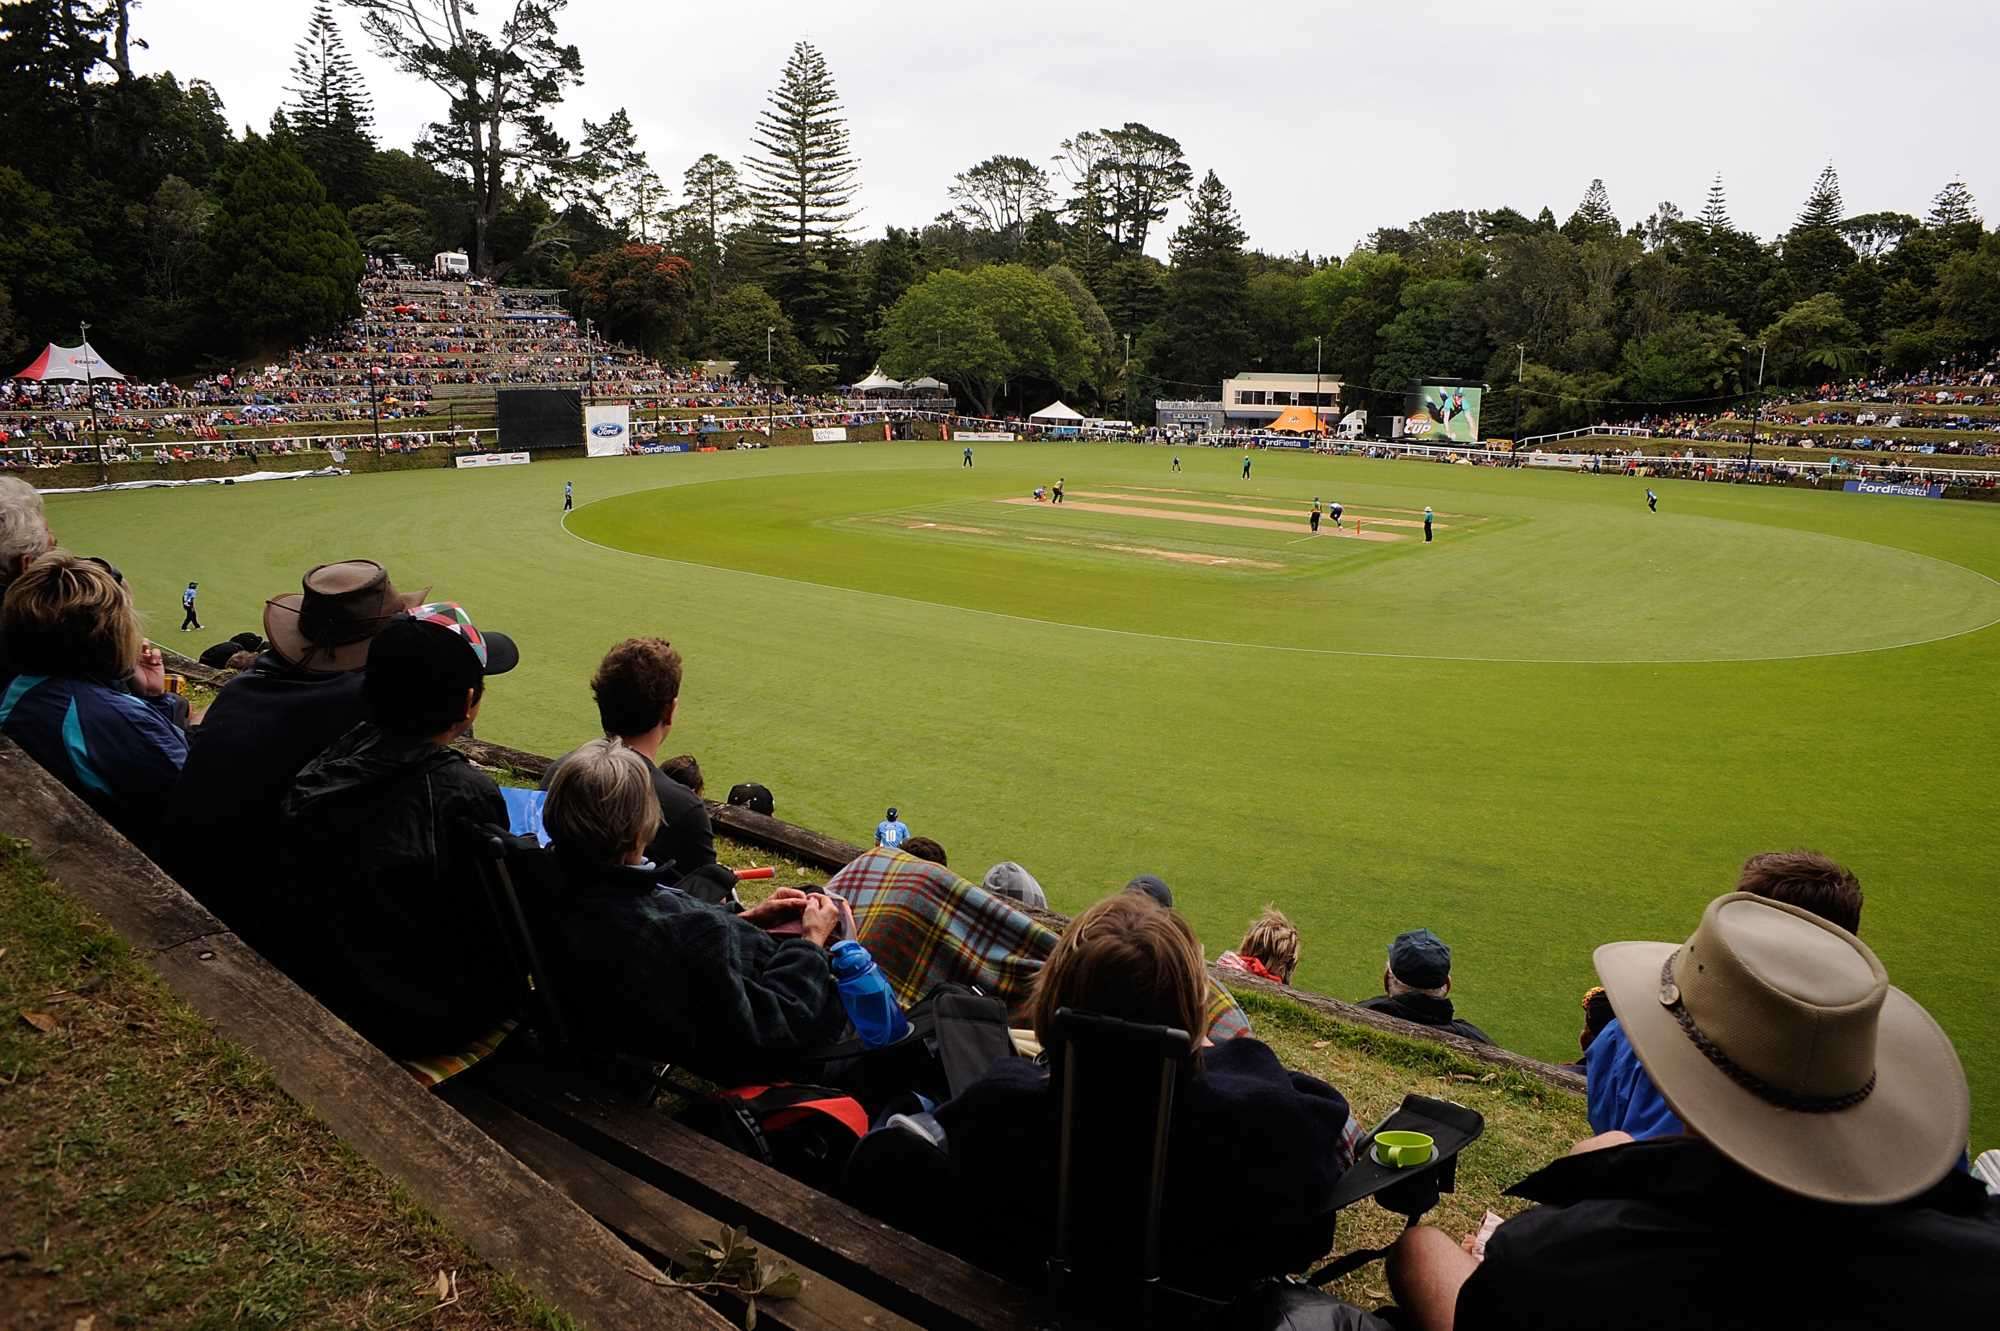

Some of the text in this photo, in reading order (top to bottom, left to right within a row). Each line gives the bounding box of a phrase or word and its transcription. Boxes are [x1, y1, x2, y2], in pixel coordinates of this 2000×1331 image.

[597, 424, 618, 435] Ford
[1404, 423, 1431, 434] CUP
[1858, 482, 1927, 496] FordFiesta
[886, 829, 896, 842] 10
